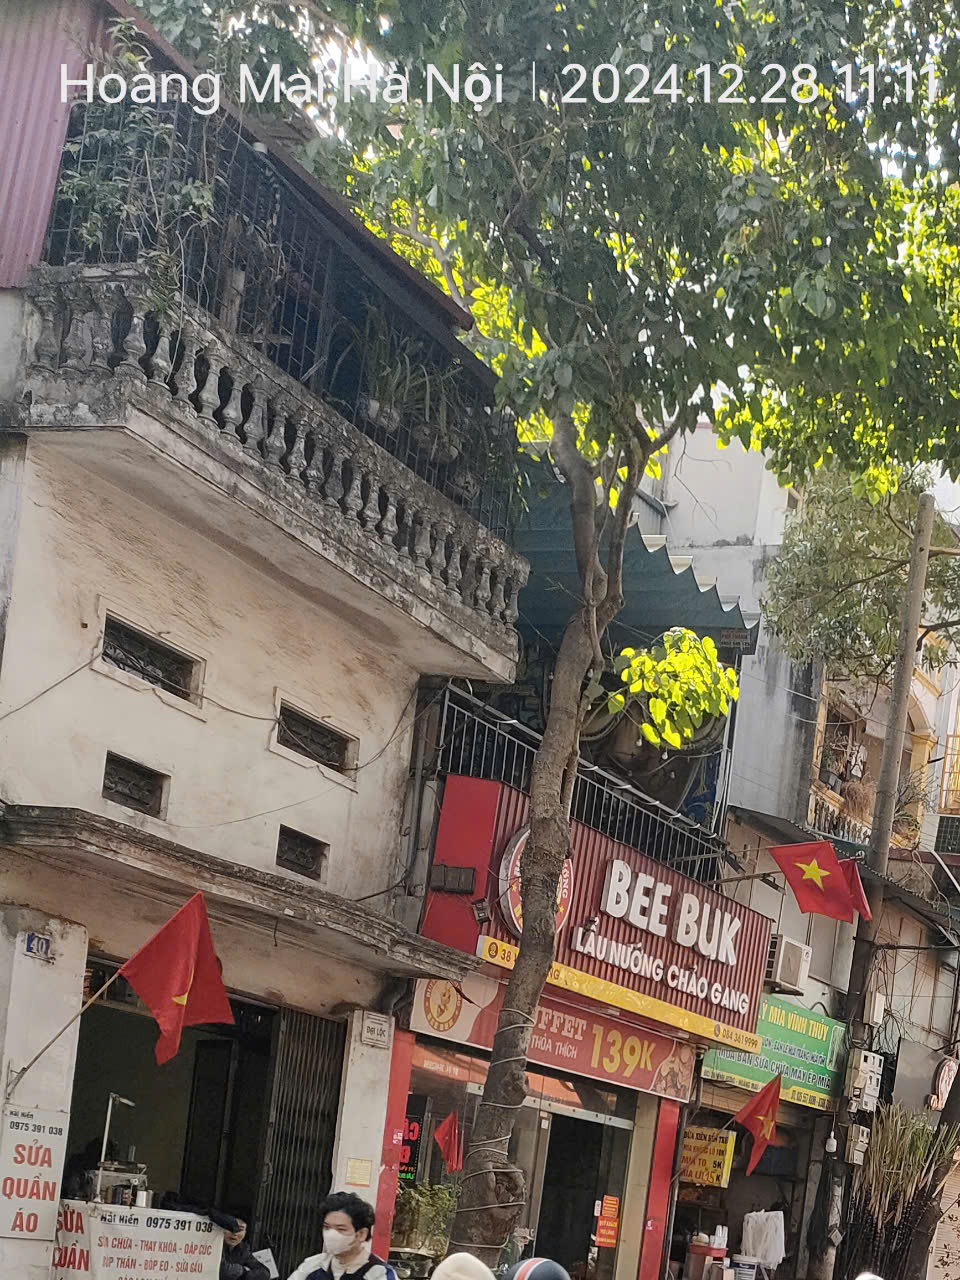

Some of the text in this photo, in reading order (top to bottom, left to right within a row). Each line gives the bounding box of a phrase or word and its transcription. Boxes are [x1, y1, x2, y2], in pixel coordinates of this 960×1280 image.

[601, 860, 672, 937] BEE
[673, 893, 741, 965] BUK
[501, 948, 511, 962] 38
[572, 915, 748, 1015] LẨU NƯỚNG CHẢO GANG
[531, 1033, 577, 1059] THỎA THÍCH
[9, 1120, 63, 1136] 0975 391 038
[13, 1139, 52, 1168] SỬA
[1, 1172, 57, 1202] QUẦN
[10, 1207, 39, 1233] ÁO
[146, 1216, 172, 1231] 0975
[173, 1218, 192, 1232] 391
[195, 1220, 214, 1234] 038
